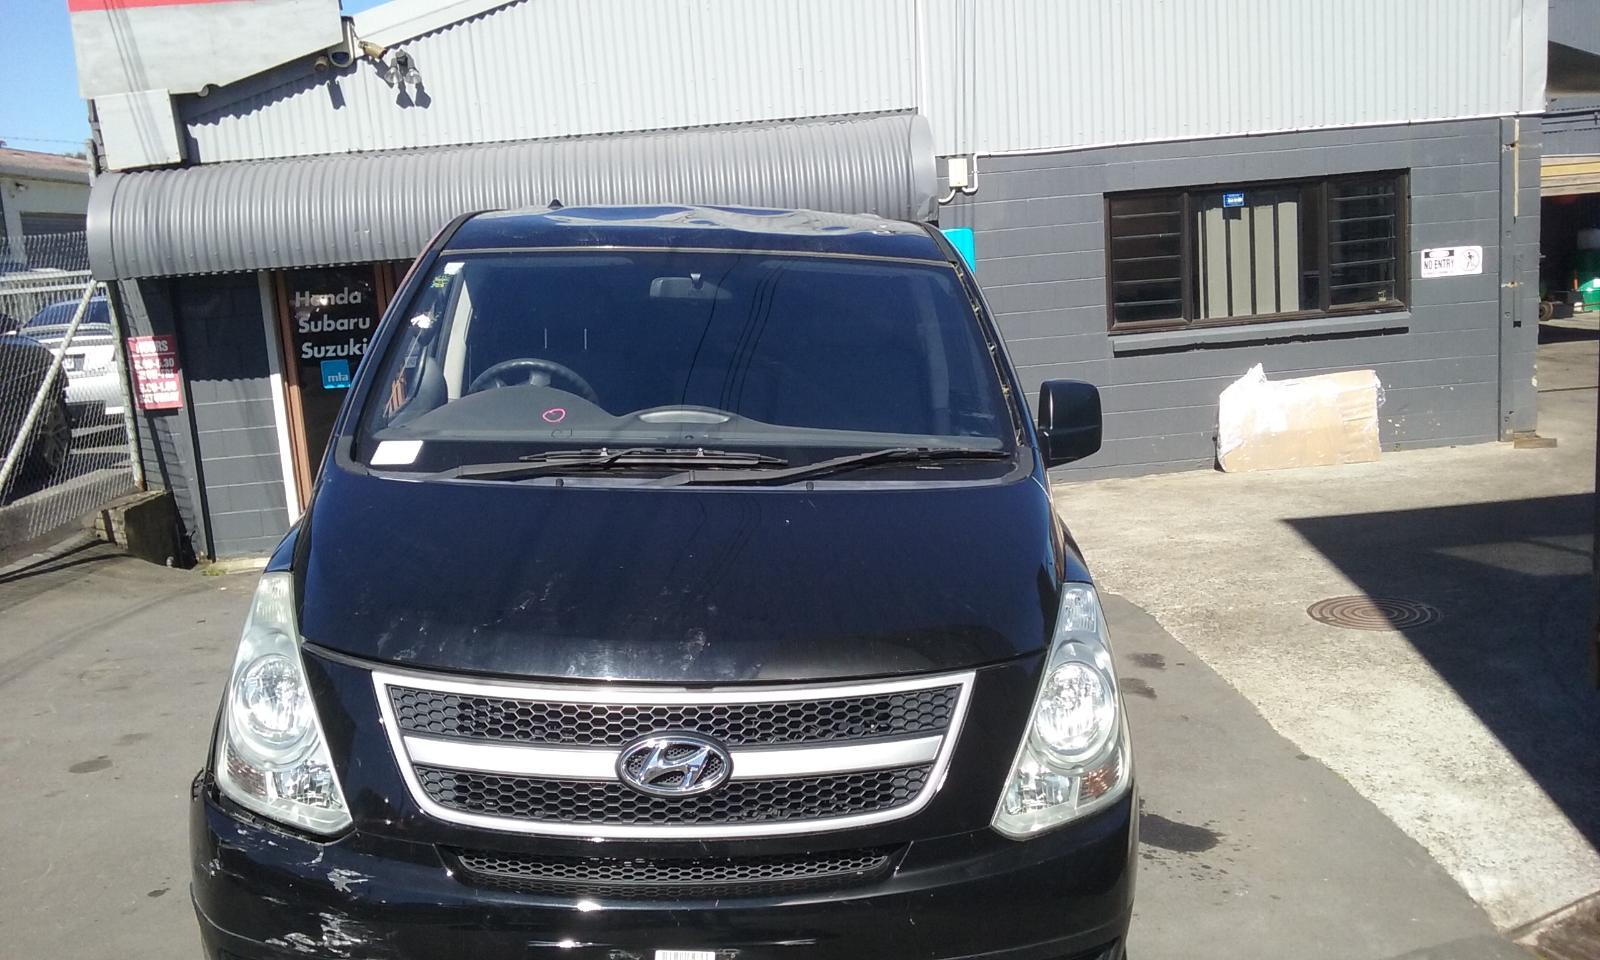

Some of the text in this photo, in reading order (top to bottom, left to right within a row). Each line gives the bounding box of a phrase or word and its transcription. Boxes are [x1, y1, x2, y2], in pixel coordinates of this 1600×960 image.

[1424, 258, 1454, 270] NO ENTRY
[295, 287, 362, 307] Honda
[298, 314, 370, 333] Subaru
[301, 338, 368, 358] Suzuki
